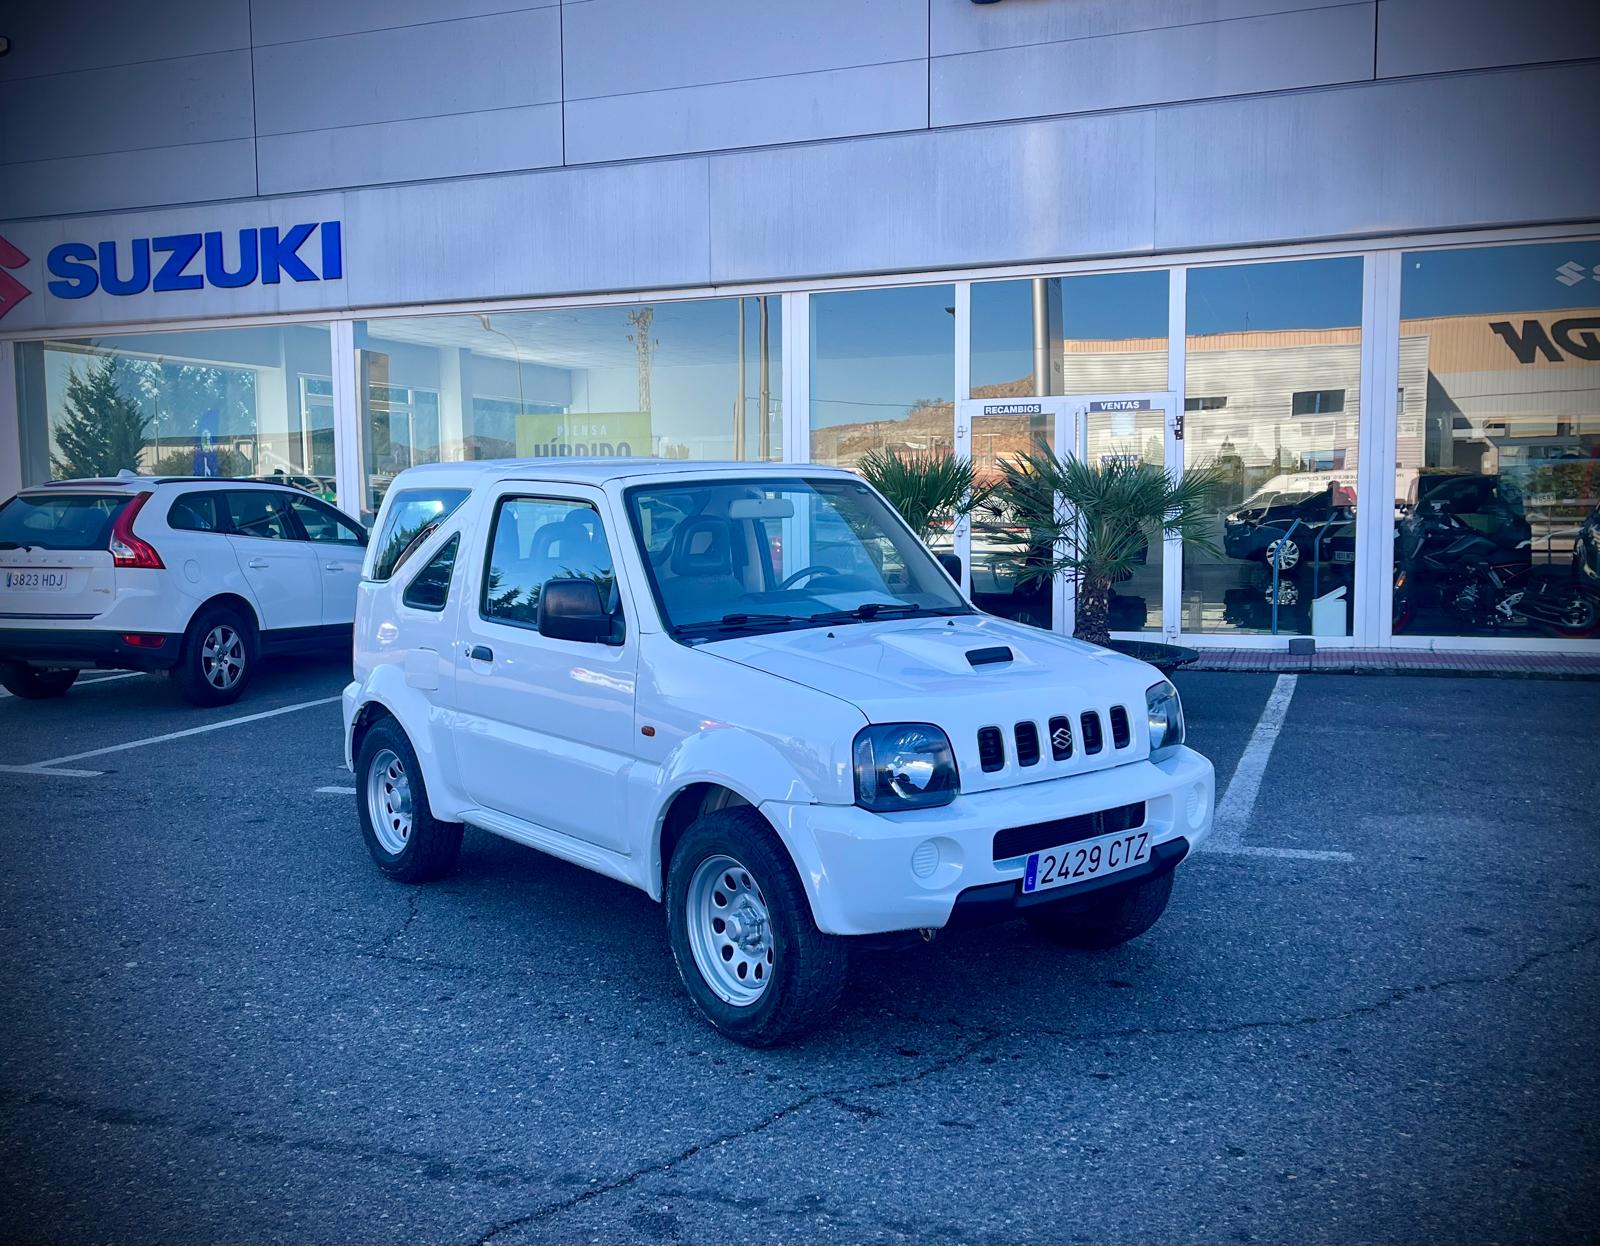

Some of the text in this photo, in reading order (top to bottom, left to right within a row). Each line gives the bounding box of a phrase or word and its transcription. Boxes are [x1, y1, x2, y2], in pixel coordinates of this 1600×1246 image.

[47, 220, 342, 299] SUZUKI
[985, 405, 1040, 415] RECAMBIOS
[1101, 401, 1140, 410] VENTAS
[12, 574, 63, 587] 3823 HDJ
[1040, 832, 1149, 885] 2429 CTZ
